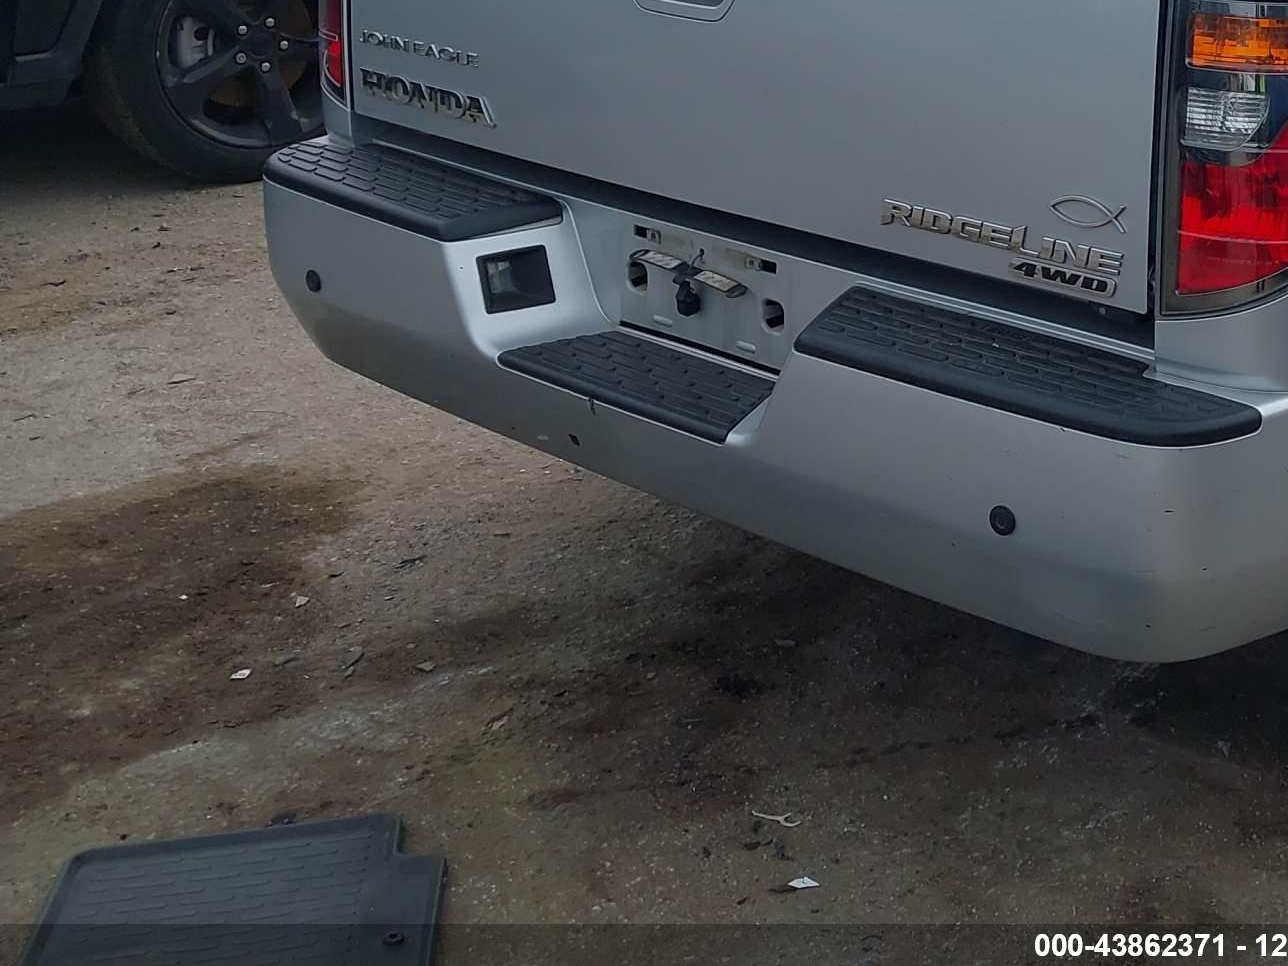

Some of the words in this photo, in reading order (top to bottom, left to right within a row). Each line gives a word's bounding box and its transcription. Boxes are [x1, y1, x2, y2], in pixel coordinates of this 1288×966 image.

[359, 29, 410, 53] JOHN
[412, 40, 480, 68] EAGLE
[359, 66, 497, 129] HONDA
[880, 197, 1125, 276] RIDGELINE
[1012, 261, 1110, 294] 4WD
